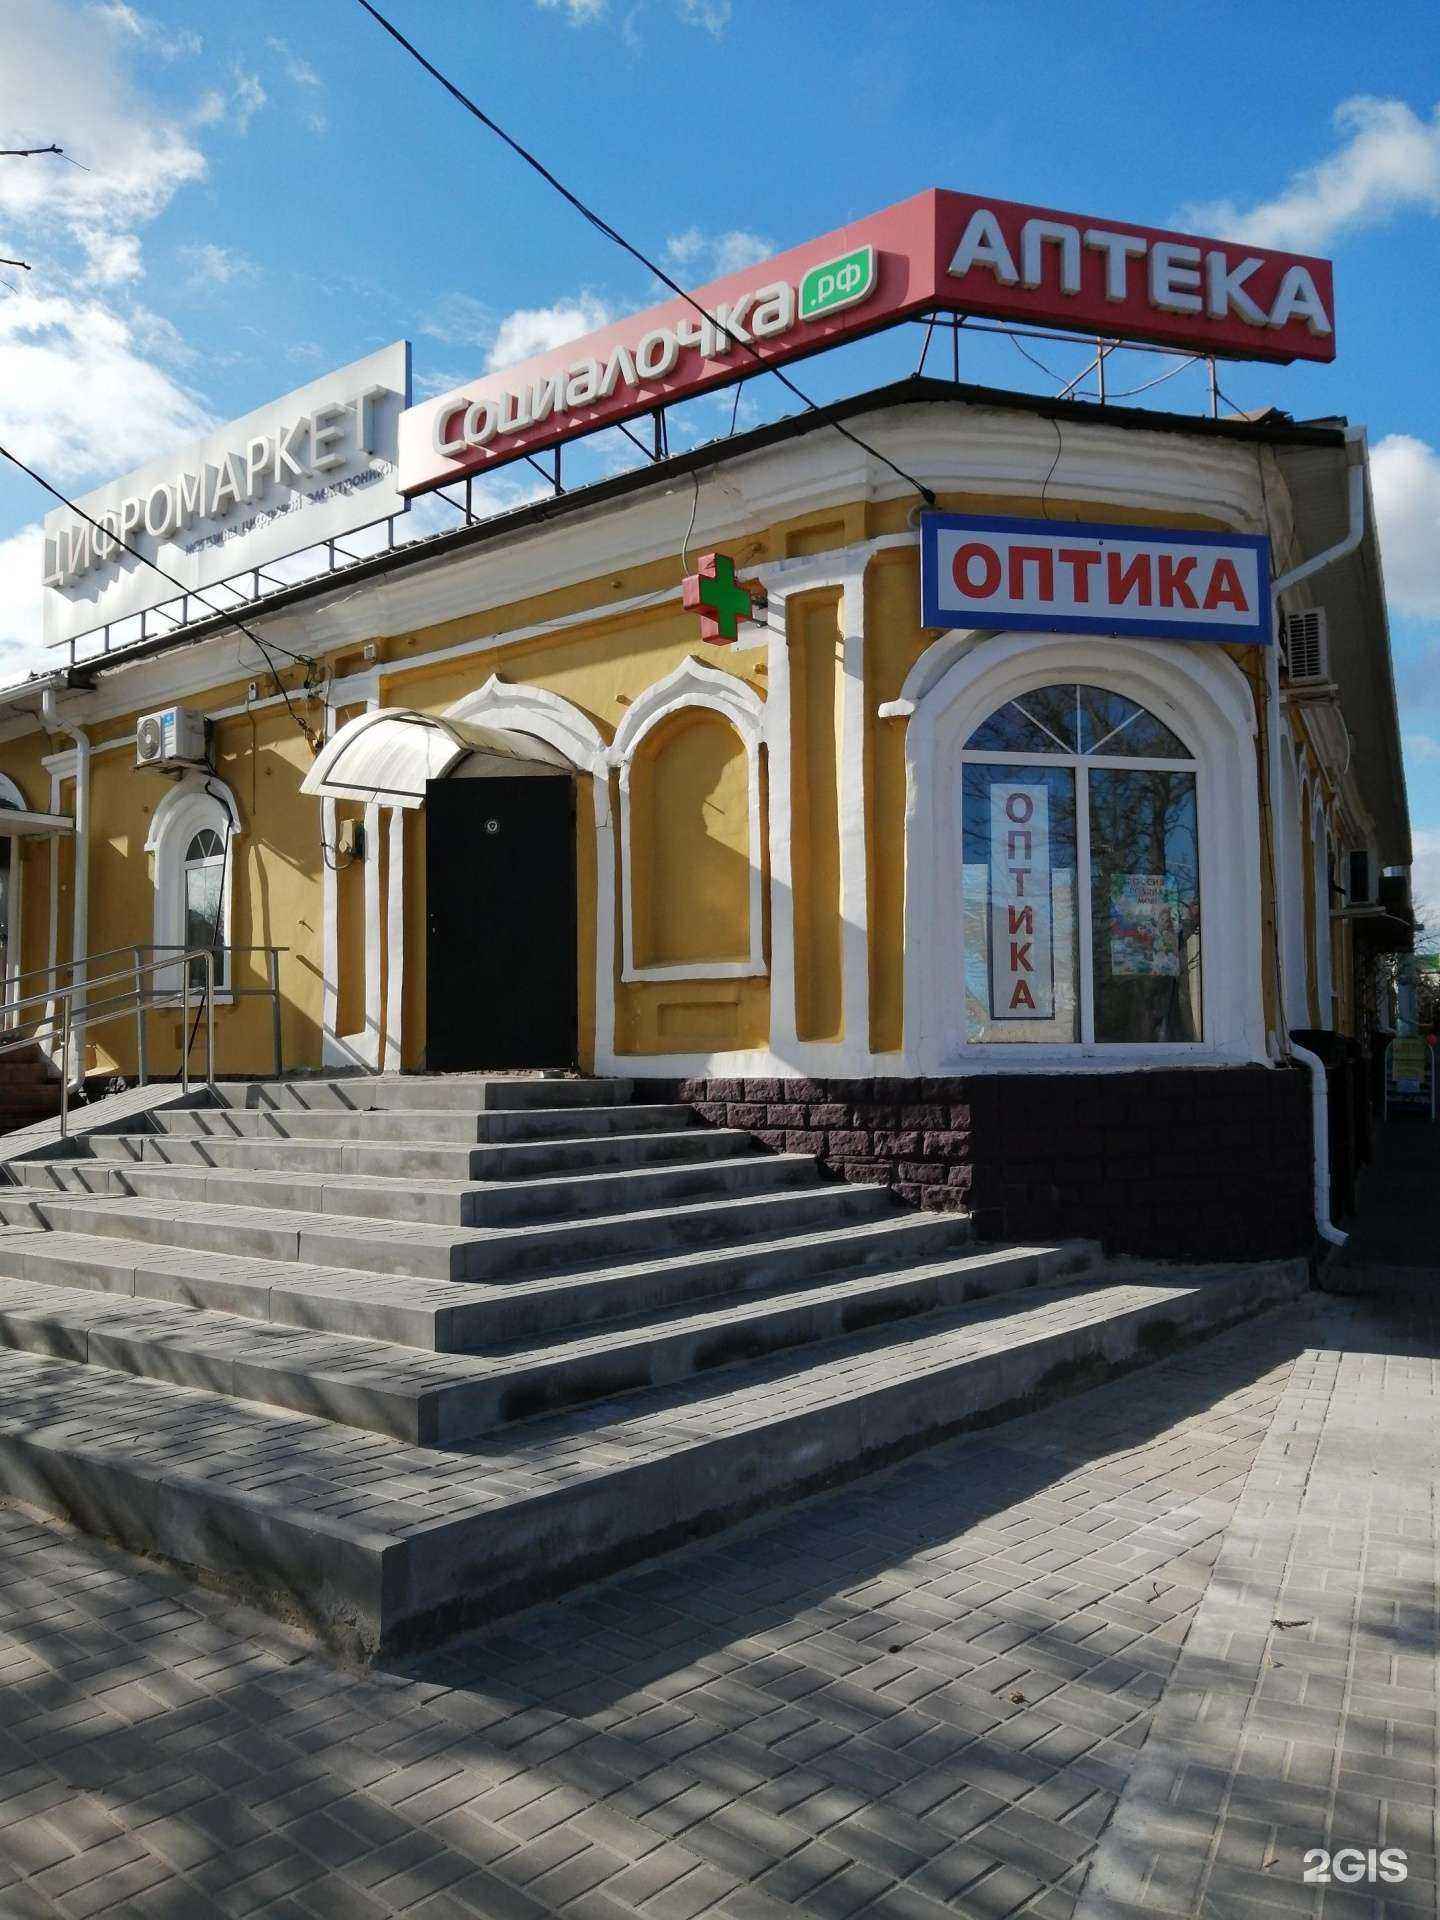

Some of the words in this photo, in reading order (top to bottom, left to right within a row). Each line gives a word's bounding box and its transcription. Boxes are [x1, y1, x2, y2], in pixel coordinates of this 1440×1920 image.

[432, 280, 795, 457] Социалочка
[809, 261, 863, 307] .рф
[948, 208, 1332, 338] АПТЕКА
[41, 384, 389, 587] ЦИФРОМАРКЕТ
[952, 542, 1250, 613] ОПТИКА
[1005, 793, 1036, 1009] ОПТИКА
